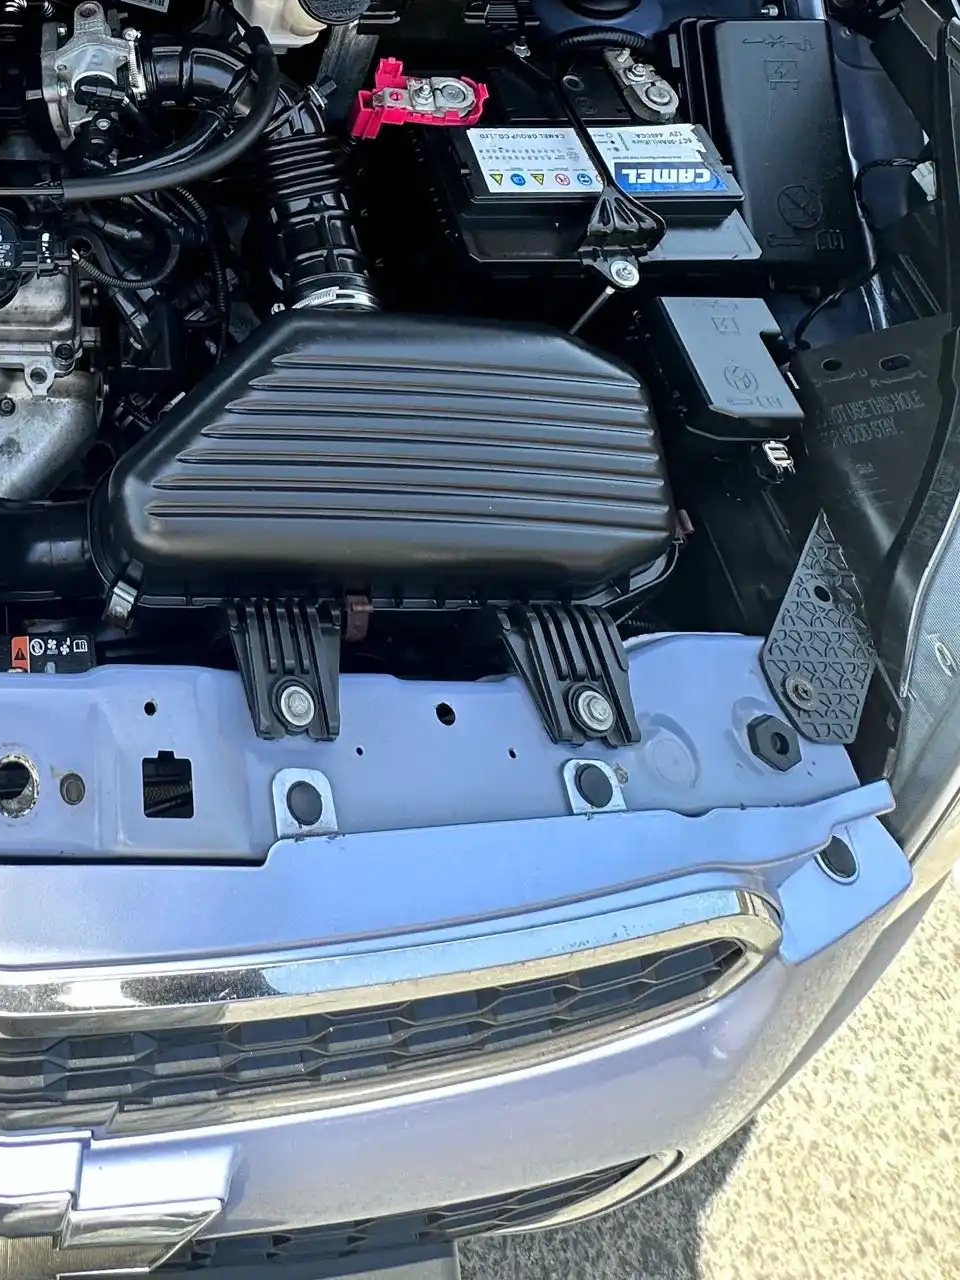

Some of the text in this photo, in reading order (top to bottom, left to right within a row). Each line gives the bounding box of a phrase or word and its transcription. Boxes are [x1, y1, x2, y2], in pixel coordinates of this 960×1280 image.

[622, 168, 711, 184] CAMEL
[847, 399, 871, 420] USE
[869, 394, 895, 416] THIS
[891, 390, 925, 411] HOLE
